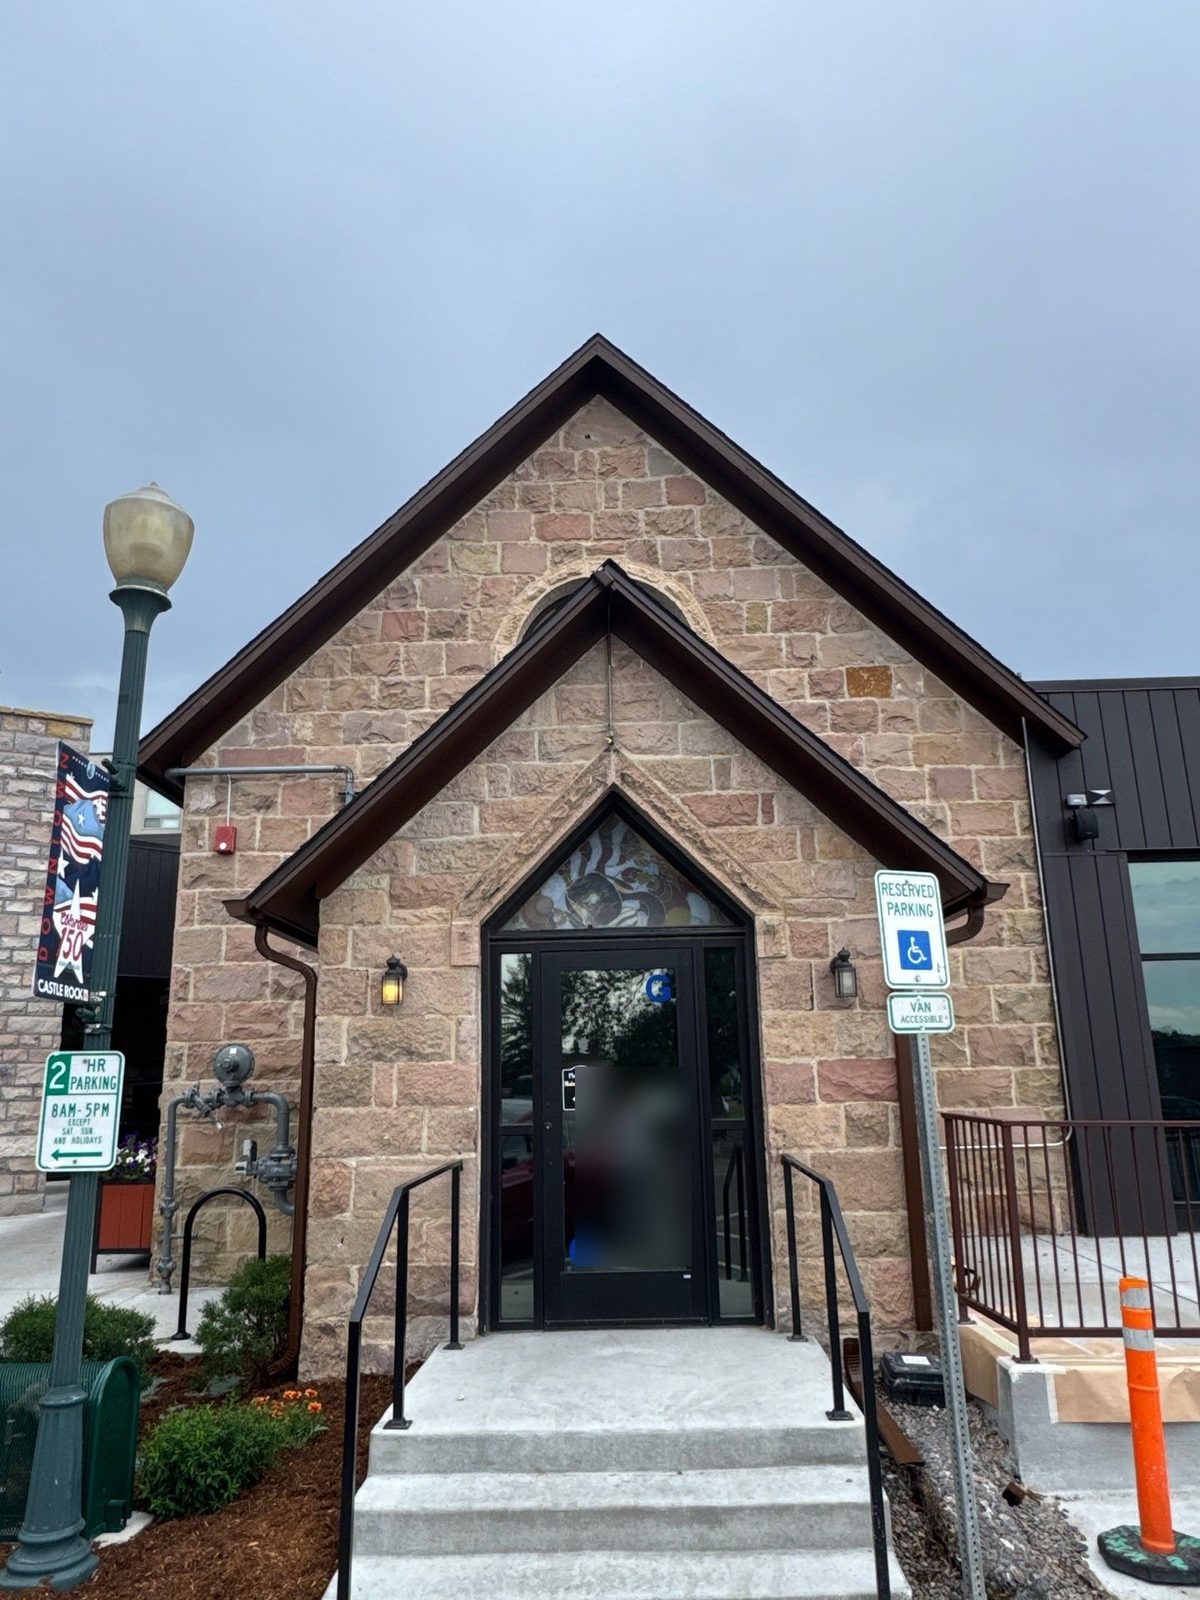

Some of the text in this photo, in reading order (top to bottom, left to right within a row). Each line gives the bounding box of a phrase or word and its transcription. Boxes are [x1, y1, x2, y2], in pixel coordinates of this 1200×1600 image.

[38, 752, 70, 961] DOWNTOWN
[880, 882, 935, 899] RESERVED
[887, 901, 934, 918] PARKING
[57, 926, 84, 961] 150
[38, 978, 84, 1000] CASTLE ROCK
[910, 1001, 932, 1013] VAN
[900, 1014, 944, 1024] ACCESSIBLE
[49, 1058, 106, 1089] 2 HR
[70, 1075, 117, 1090] PARKING
[62, 1126, 94, 1135] SAT SUN
[68, 1118, 91, 1127] EXCEPT
[53, 1135, 102, 1145] AND HOLIDAYS
